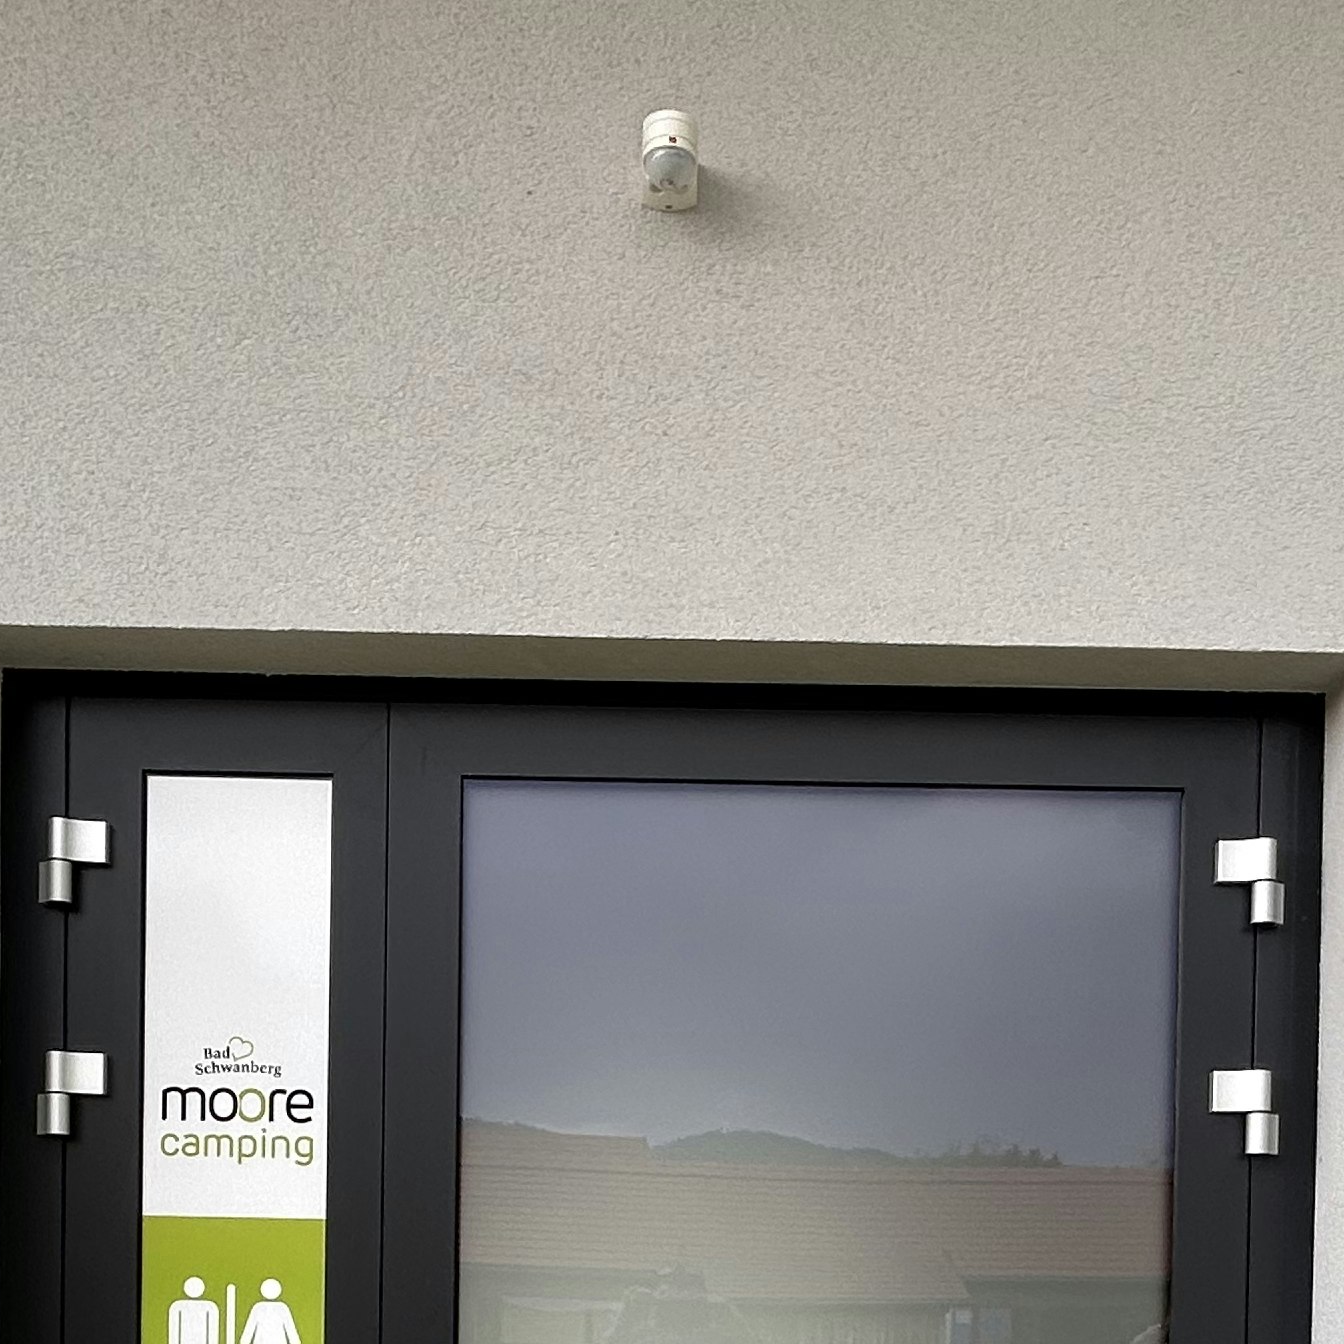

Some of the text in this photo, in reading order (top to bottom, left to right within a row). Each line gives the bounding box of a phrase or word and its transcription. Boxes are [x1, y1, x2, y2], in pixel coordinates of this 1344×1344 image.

[203, 1045, 230, 1060] Bad
[194, 1060, 282, 1078] Schwanberg
[161, 1086, 314, 1124] moore
[160, 1128, 314, 1166] camping
